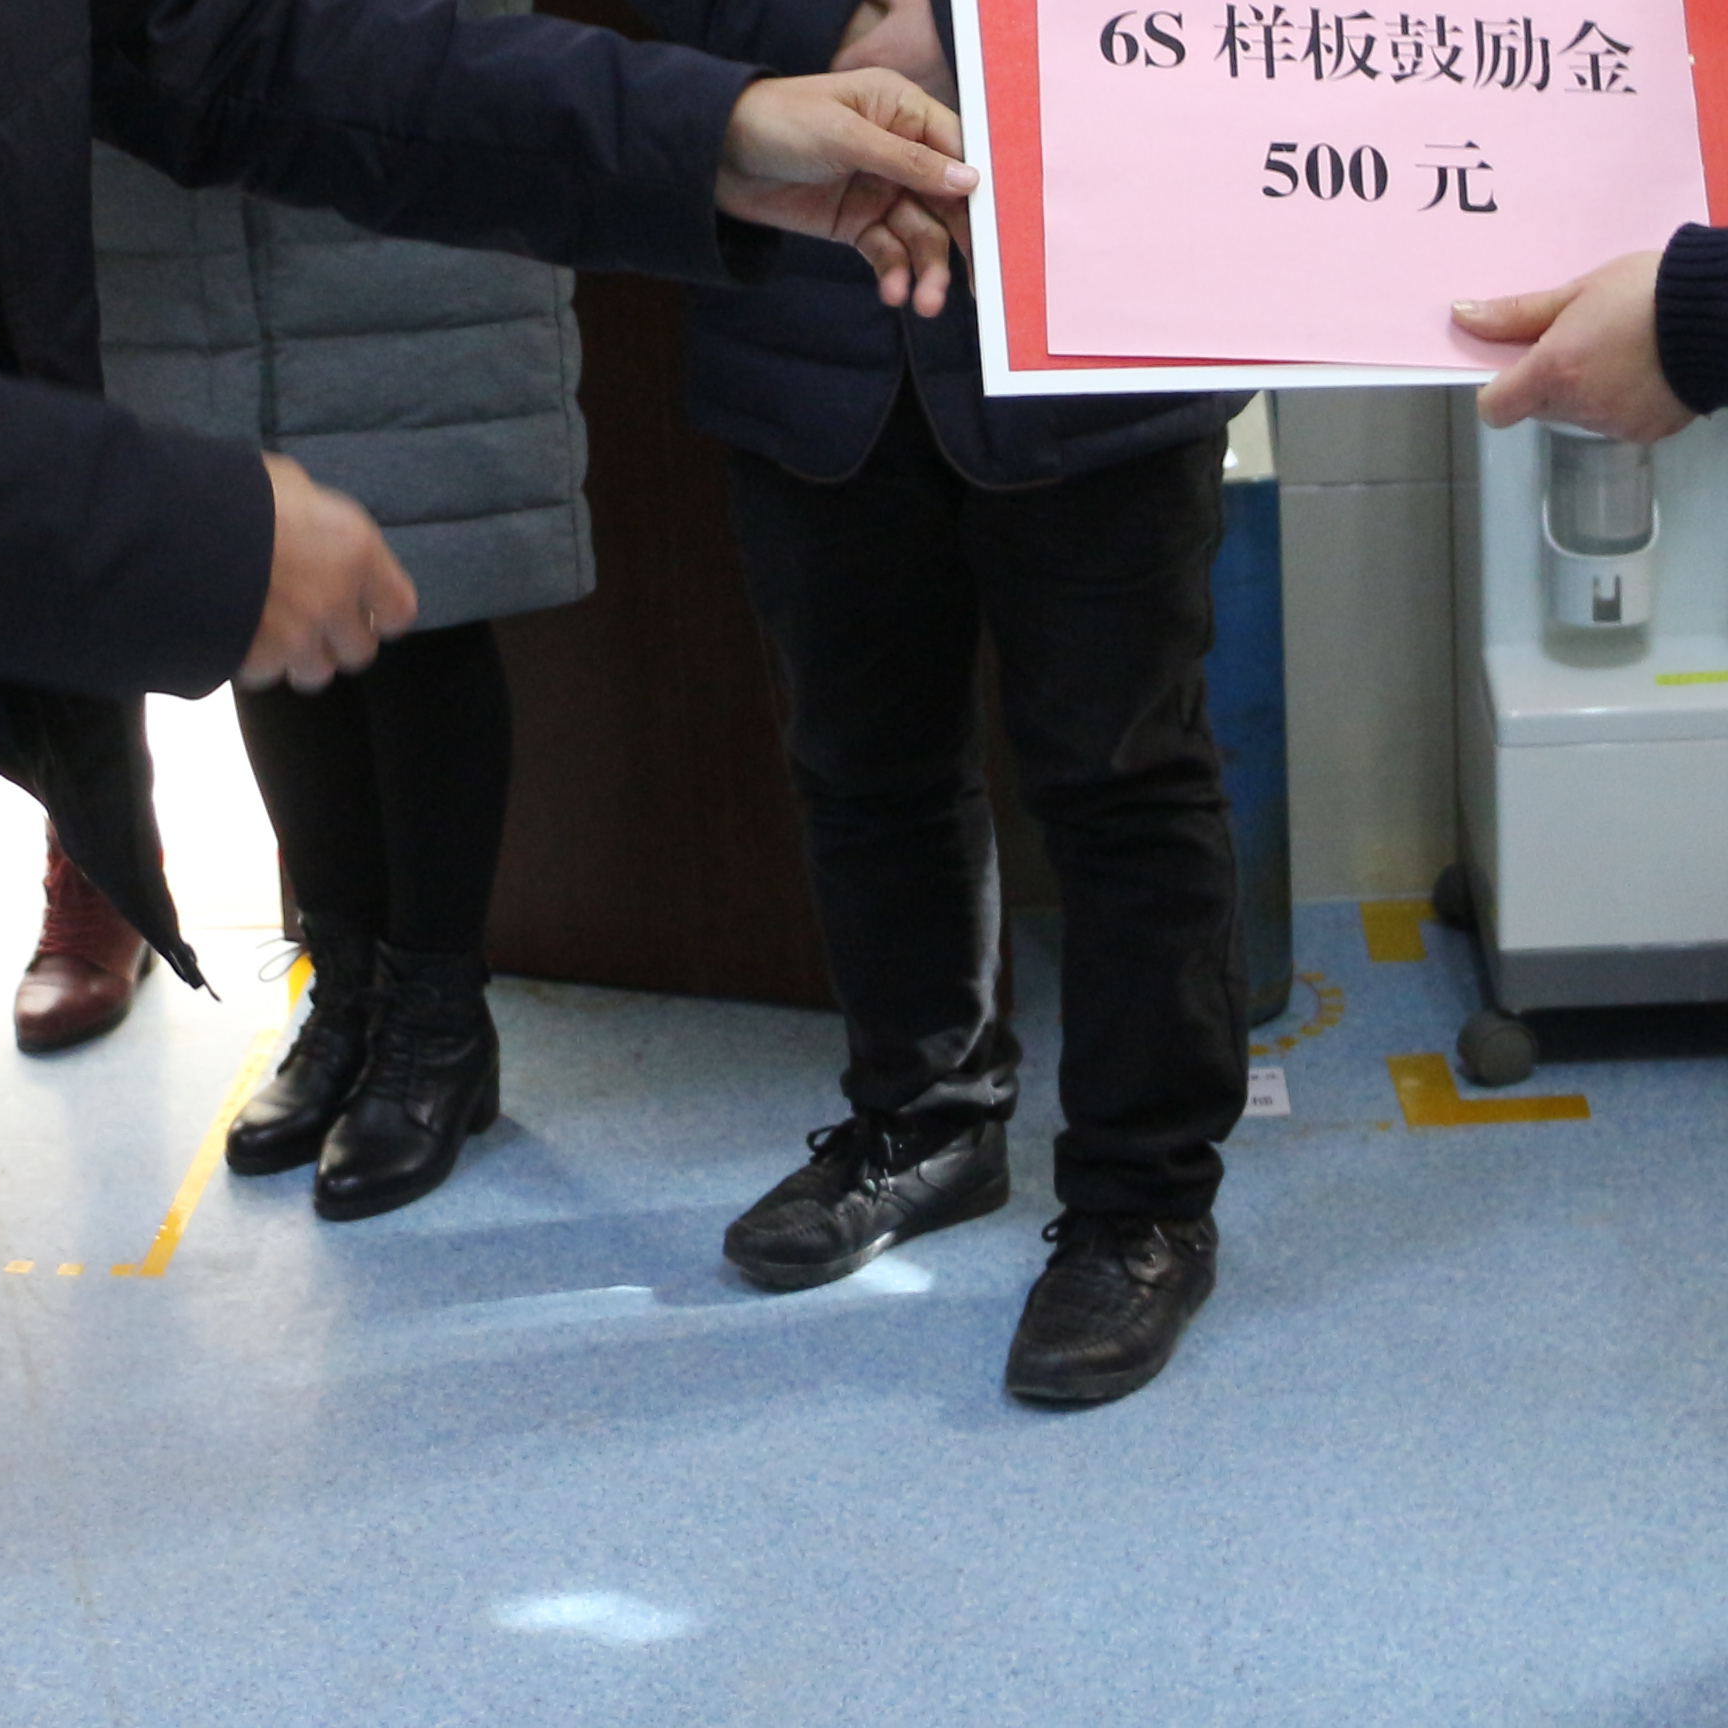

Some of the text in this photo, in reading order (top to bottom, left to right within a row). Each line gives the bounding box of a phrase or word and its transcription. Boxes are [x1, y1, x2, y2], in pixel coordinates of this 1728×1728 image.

[1099, 4, 1637, 97] 6S 样板鼓励金
[1261, 139, 1498, 214] 500 元
